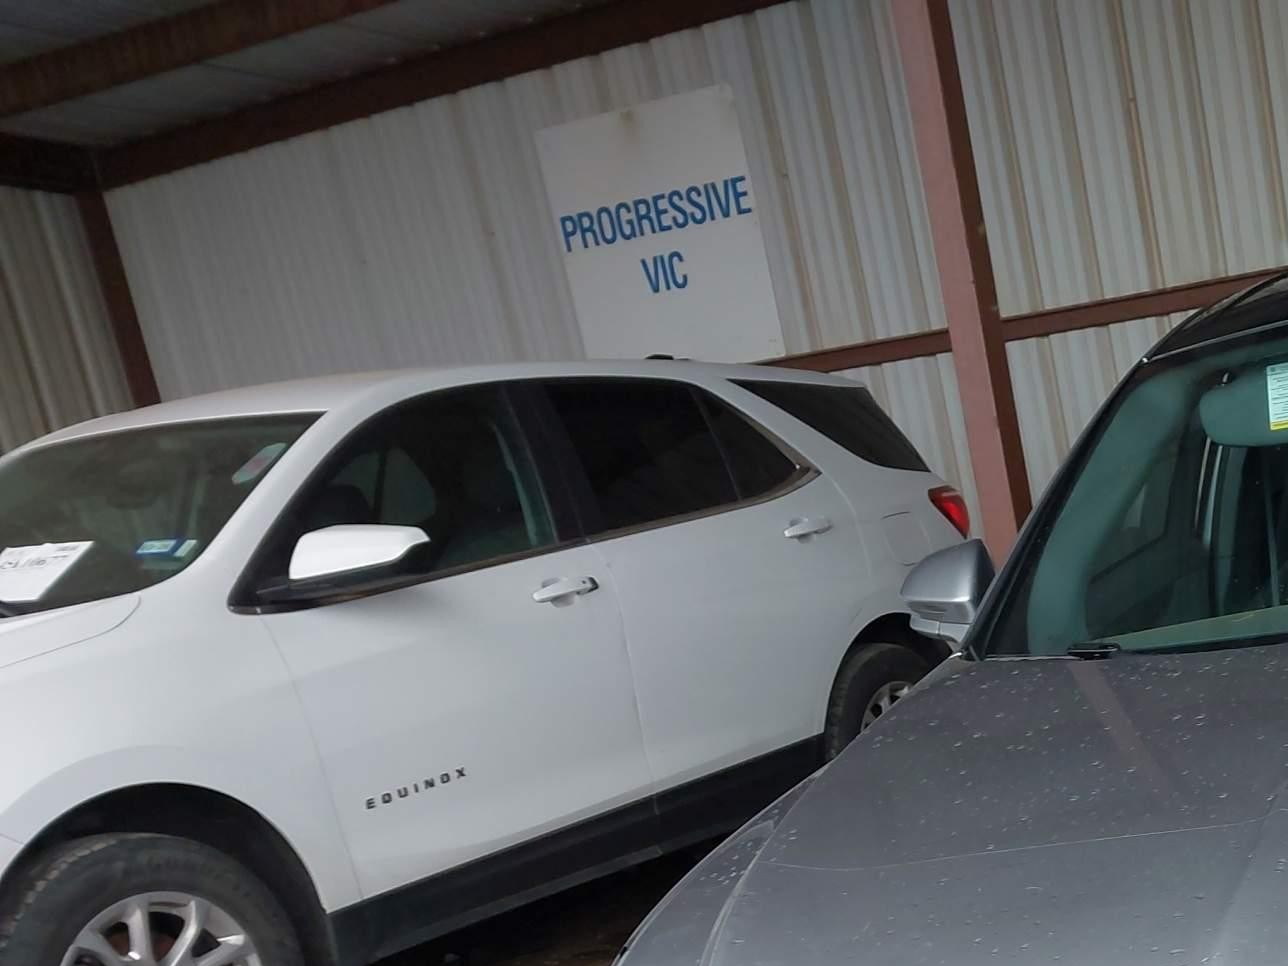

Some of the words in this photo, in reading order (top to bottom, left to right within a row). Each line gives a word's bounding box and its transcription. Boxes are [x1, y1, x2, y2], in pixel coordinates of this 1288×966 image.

[559, 175, 753, 253] PROGRESSIVE
[640, 250, 689, 294] VIC
[365, 766, 467, 810] EQUINOX
